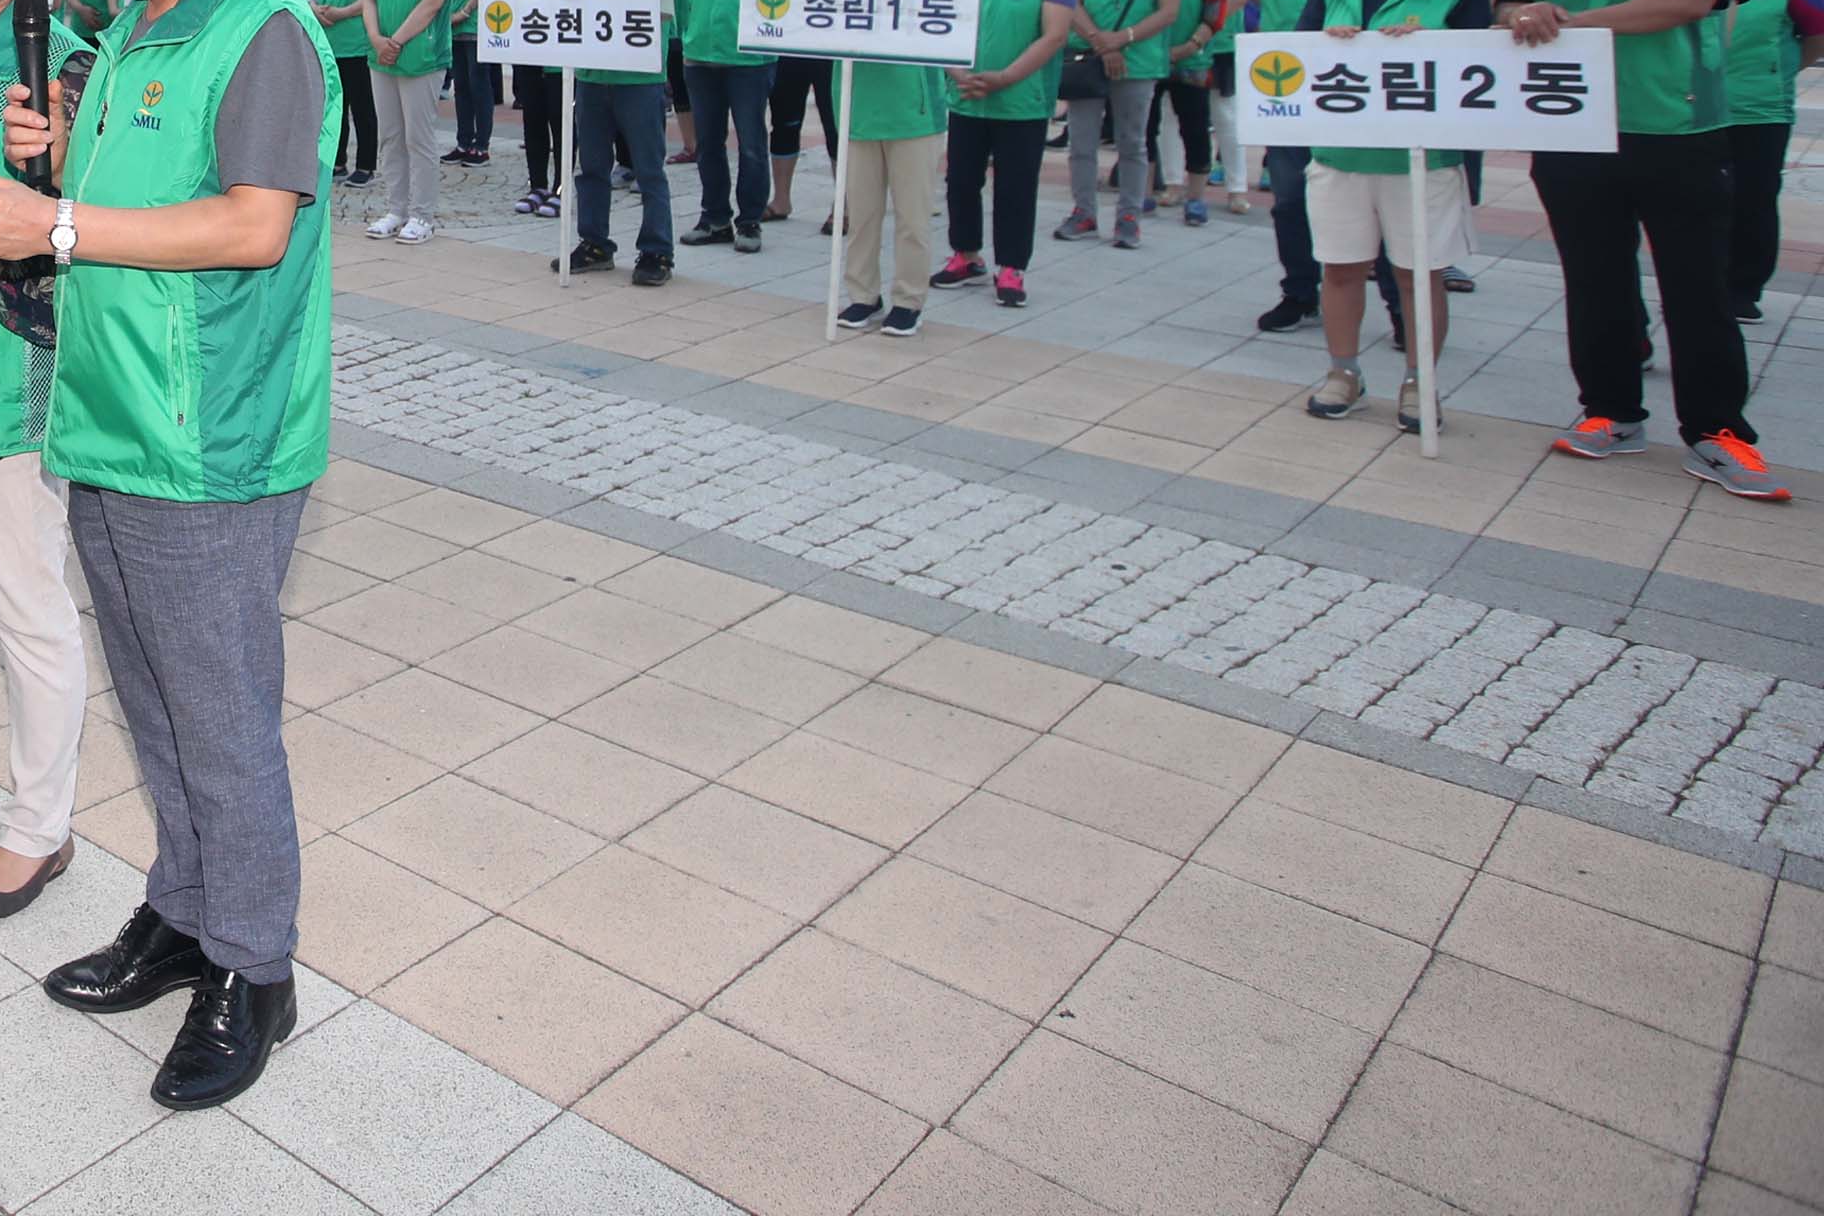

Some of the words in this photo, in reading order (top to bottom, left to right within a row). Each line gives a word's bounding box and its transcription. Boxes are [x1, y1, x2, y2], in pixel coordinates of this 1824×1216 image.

[757, 25, 783, 38] SMU
[487, 37, 510, 48] SMU
[1257, 104, 1301, 117] SMU
[131, 111, 161, 131] SMU
